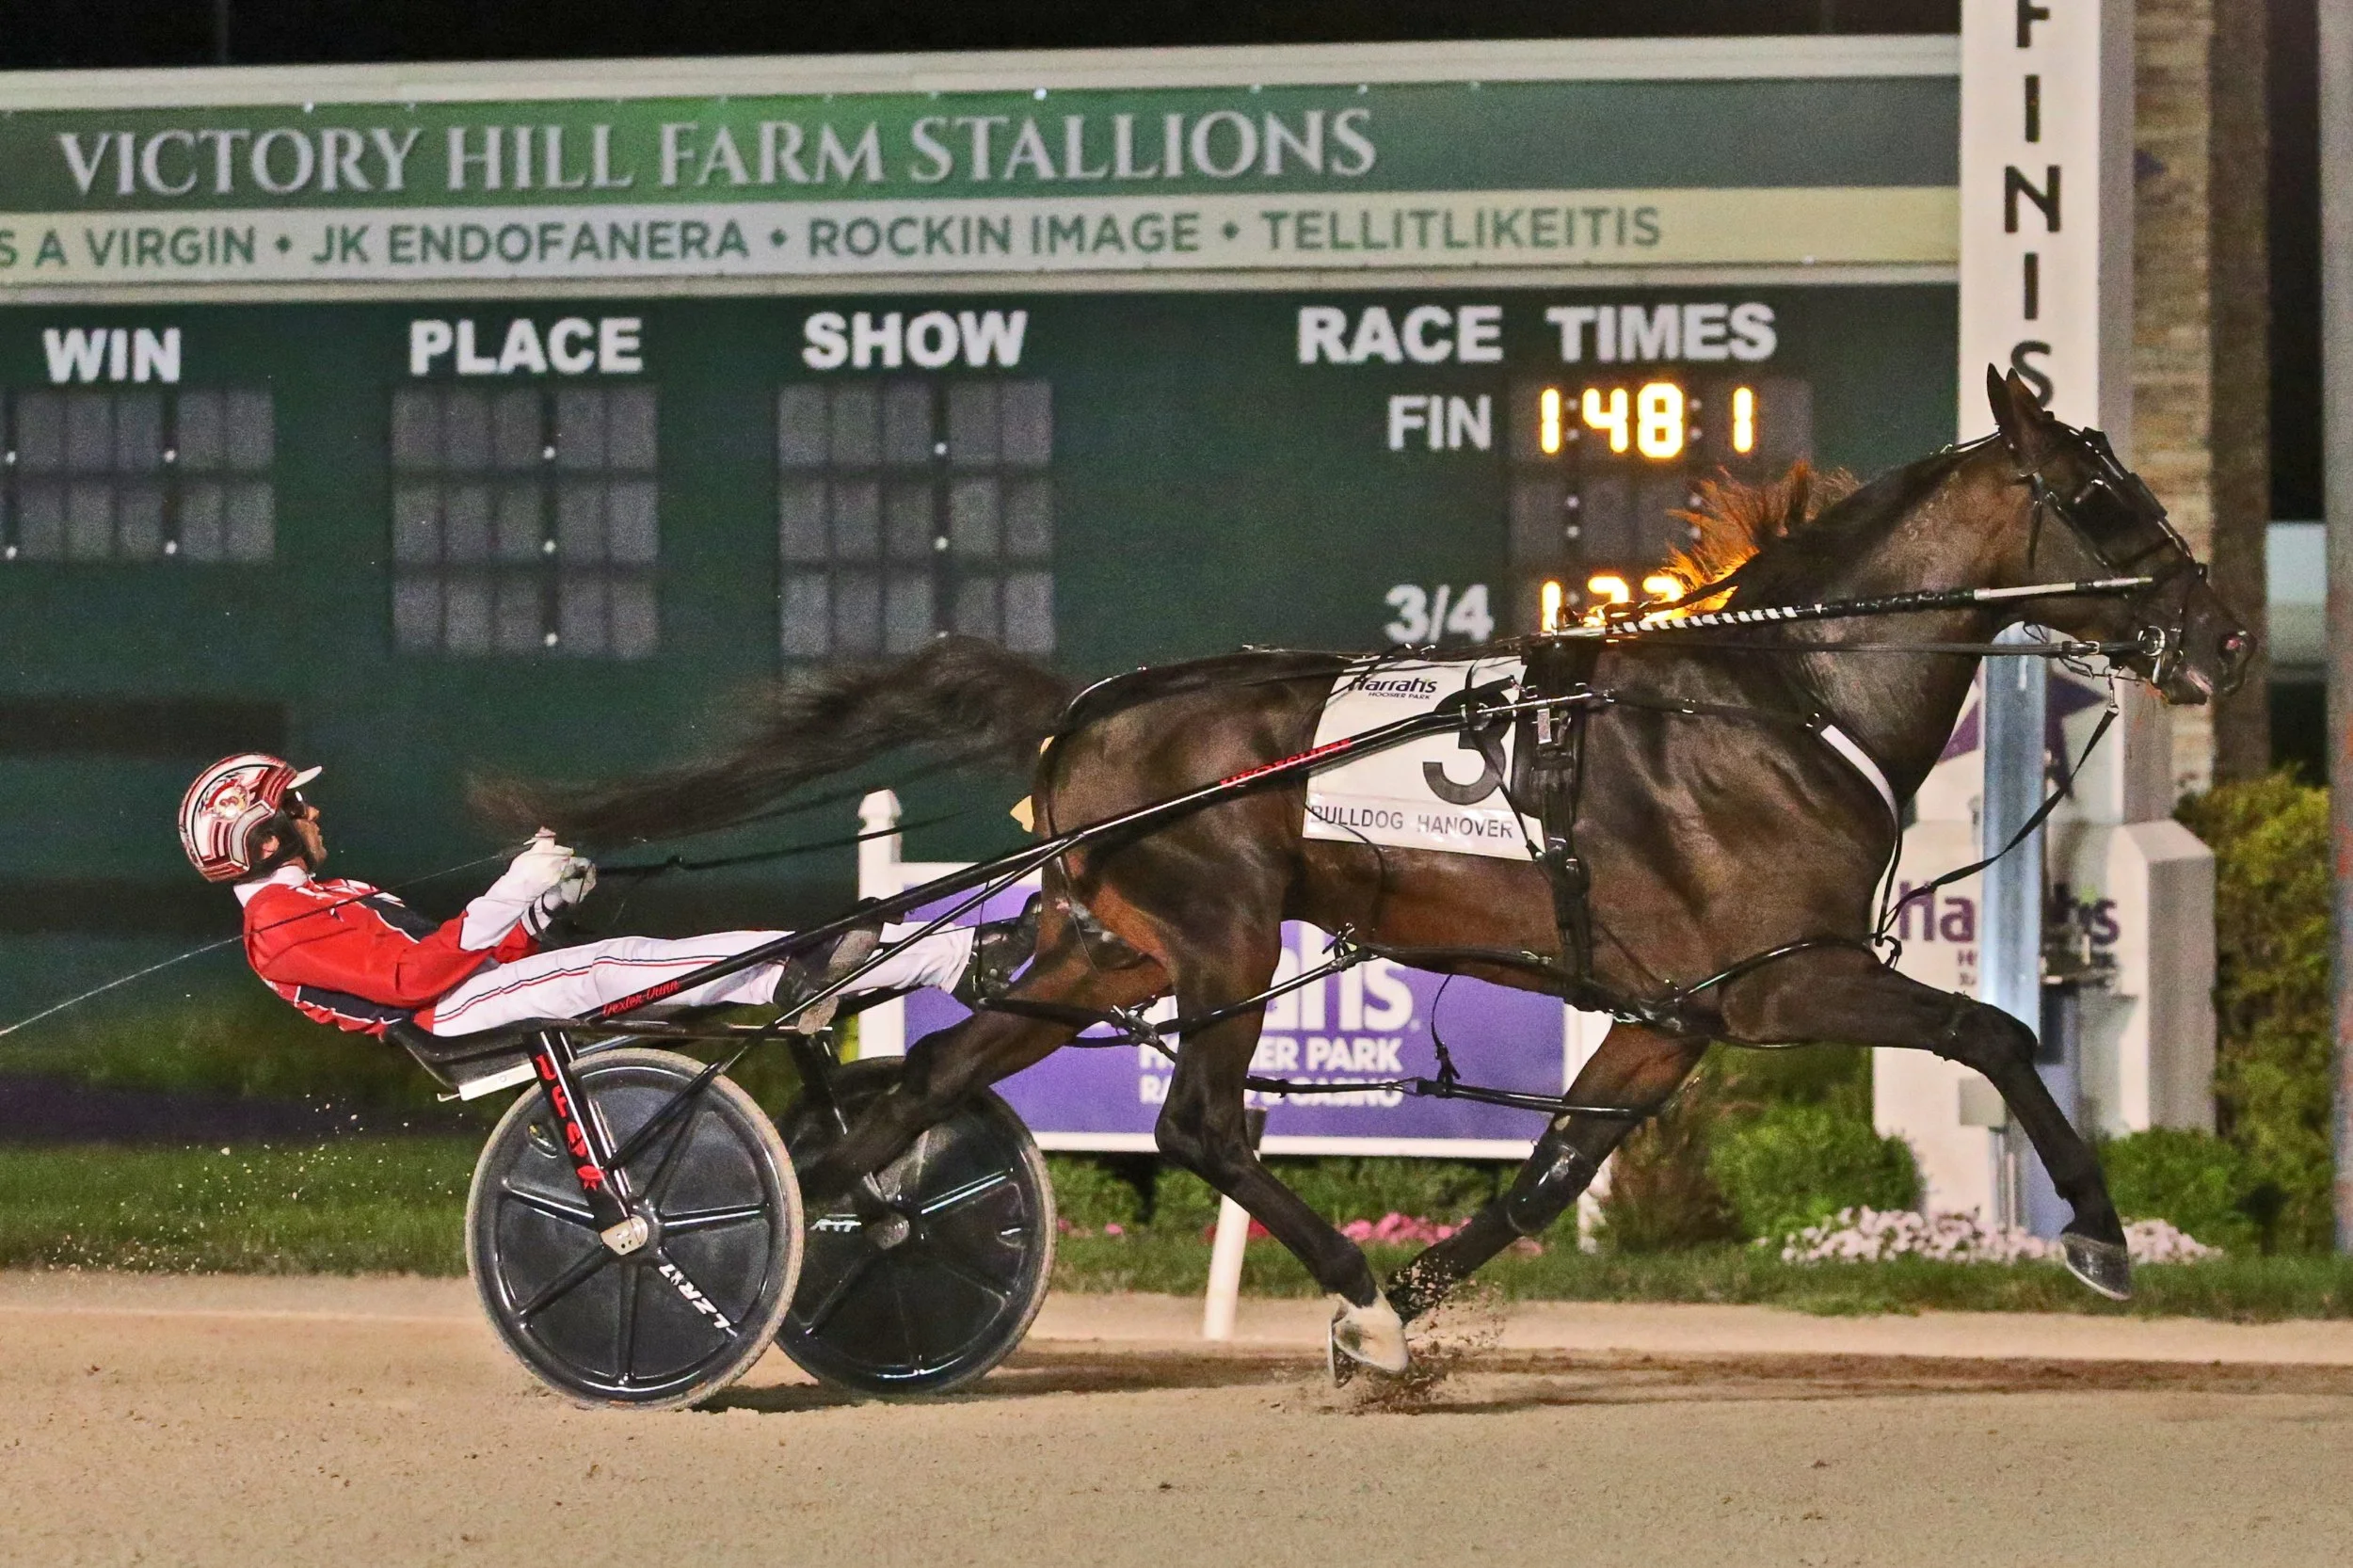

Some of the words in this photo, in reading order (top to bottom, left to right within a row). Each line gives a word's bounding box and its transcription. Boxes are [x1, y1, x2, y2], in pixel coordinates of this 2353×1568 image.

[58, 126, 420, 196] VICTORY
[447, 123, 632, 190] HILL
[659, 119, 884, 187] FARM
[909, 107, 1377, 183] STALLIONS
[34, 229, 68, 267] A
[84, 225, 255, 266] VIRGIN
[312, 223, 369, 266] JK
[390, 217, 750, 264] ENDOFANERA
[809, 216, 1010, 258] ROCKIN
[1032, 211, 1201, 254] IMAGE
[1261, 206, 1660, 252] TELLITLIKEITIS
[42, 328, 183, 384] WIN
[409, 317, 644, 376] PLACE
[802, 311, 1029, 370] SHOW
[1297, 305, 1503, 364] RACE
[1545, 302, 1778, 362] TIMES
[1387, 394, 1492, 451] FIN
[1384, 584, 1495, 644] 3/4
[1423, 684, 1513, 806] 3
[1310, 806, 1403, 830] BULLDOG
[1417, 814, 1513, 839] HANOVER
[1305, 1036, 1404, 1072] PARK
